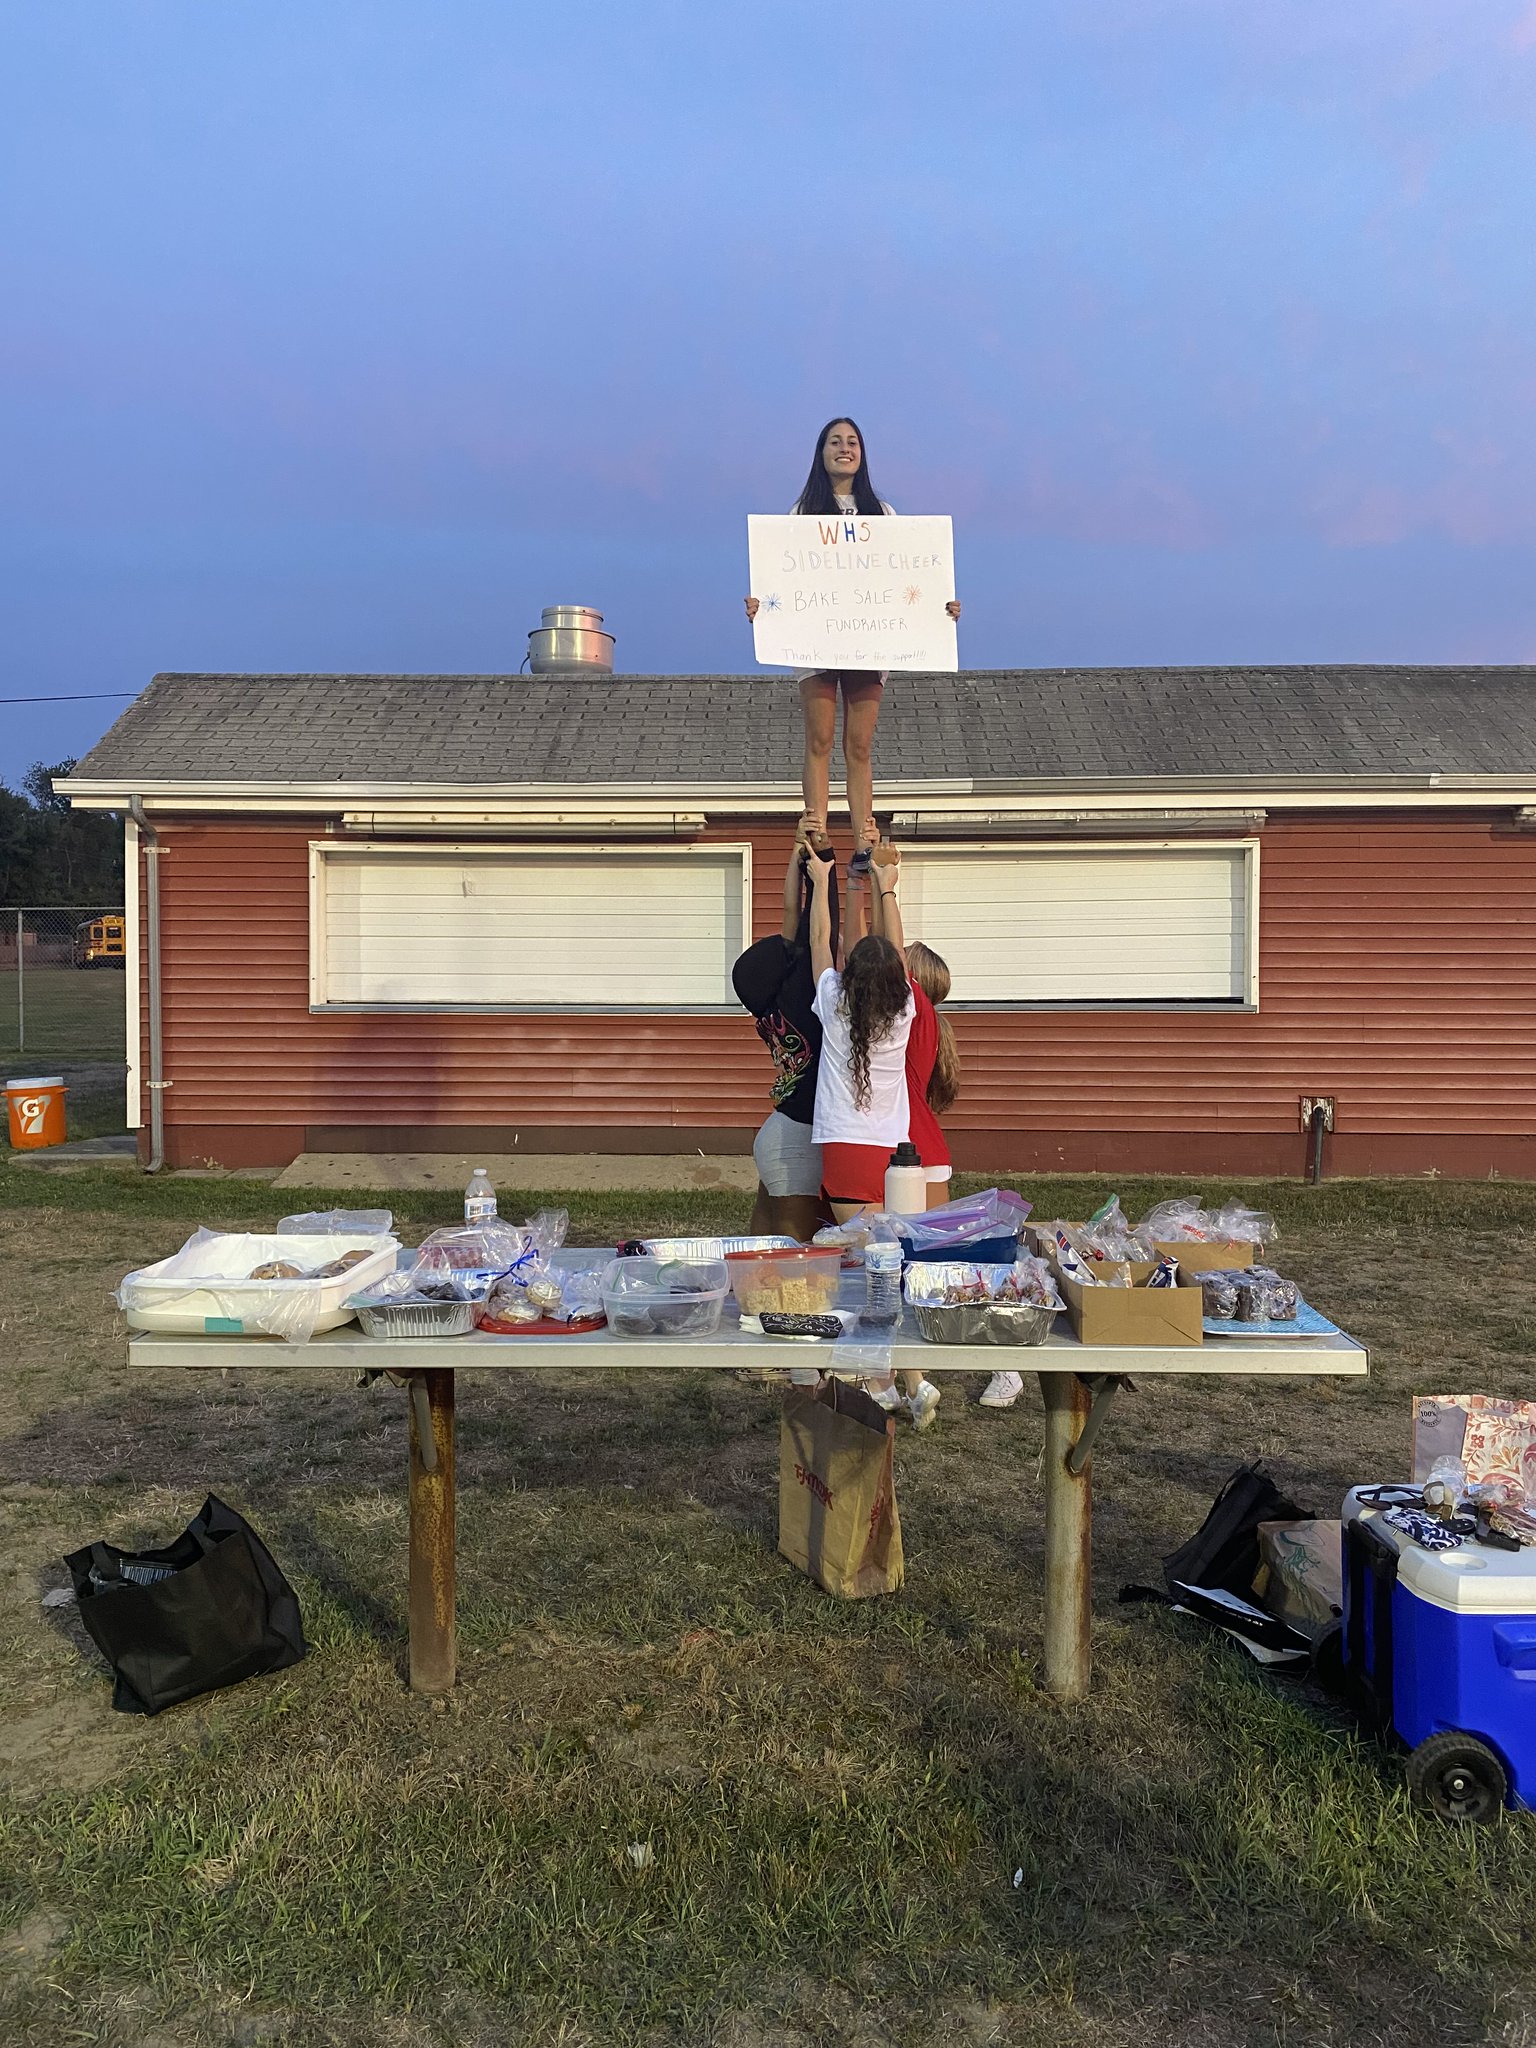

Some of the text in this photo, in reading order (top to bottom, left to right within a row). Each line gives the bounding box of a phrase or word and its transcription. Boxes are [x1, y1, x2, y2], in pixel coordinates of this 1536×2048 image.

[818, 521, 871, 545] WHS
[782, 551, 942, 573] SIDELINE CHEER
[794, 588, 893, 612] BAKE SALE
[826, 617, 908, 634] FUNDRAISER
[781, 648, 823, 662] Thank
[834, 651, 849, 666] you
[855, 649, 866, 661] for
